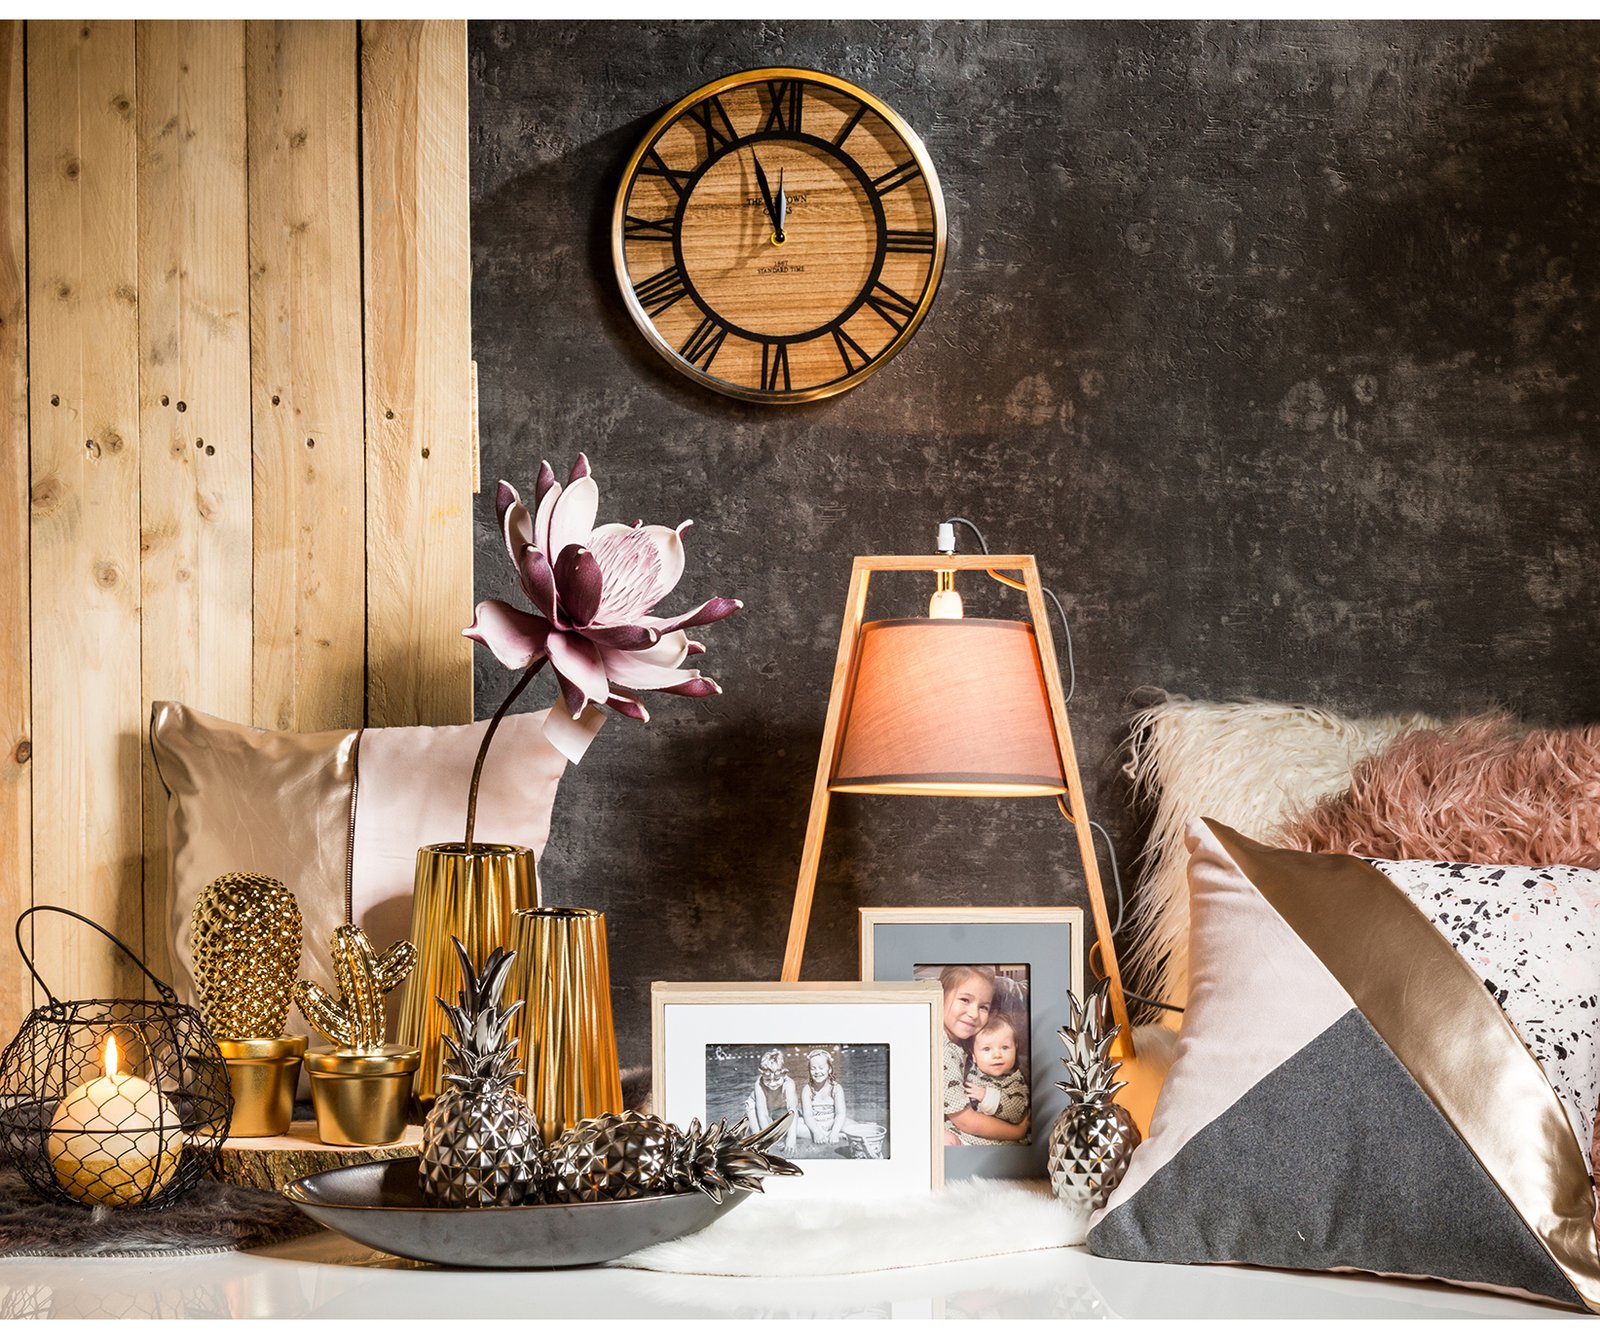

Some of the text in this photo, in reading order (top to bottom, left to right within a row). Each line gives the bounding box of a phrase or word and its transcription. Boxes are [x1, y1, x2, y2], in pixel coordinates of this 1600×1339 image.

[684, 94, 741, 158] XI
[764, 79, 804, 133] XII
[638, 148, 698, 199] X
[871, 158, 922, 198] II
[624, 214, 676, 242] IX
[885, 229, 935, 254] III
[632, 264, 690, 320] VIII
[866, 280, 918, 334] IV
[678, 316, 729, 373] VII
[760, 341, 792, 392] VI
[831, 325, 874, 376] V
